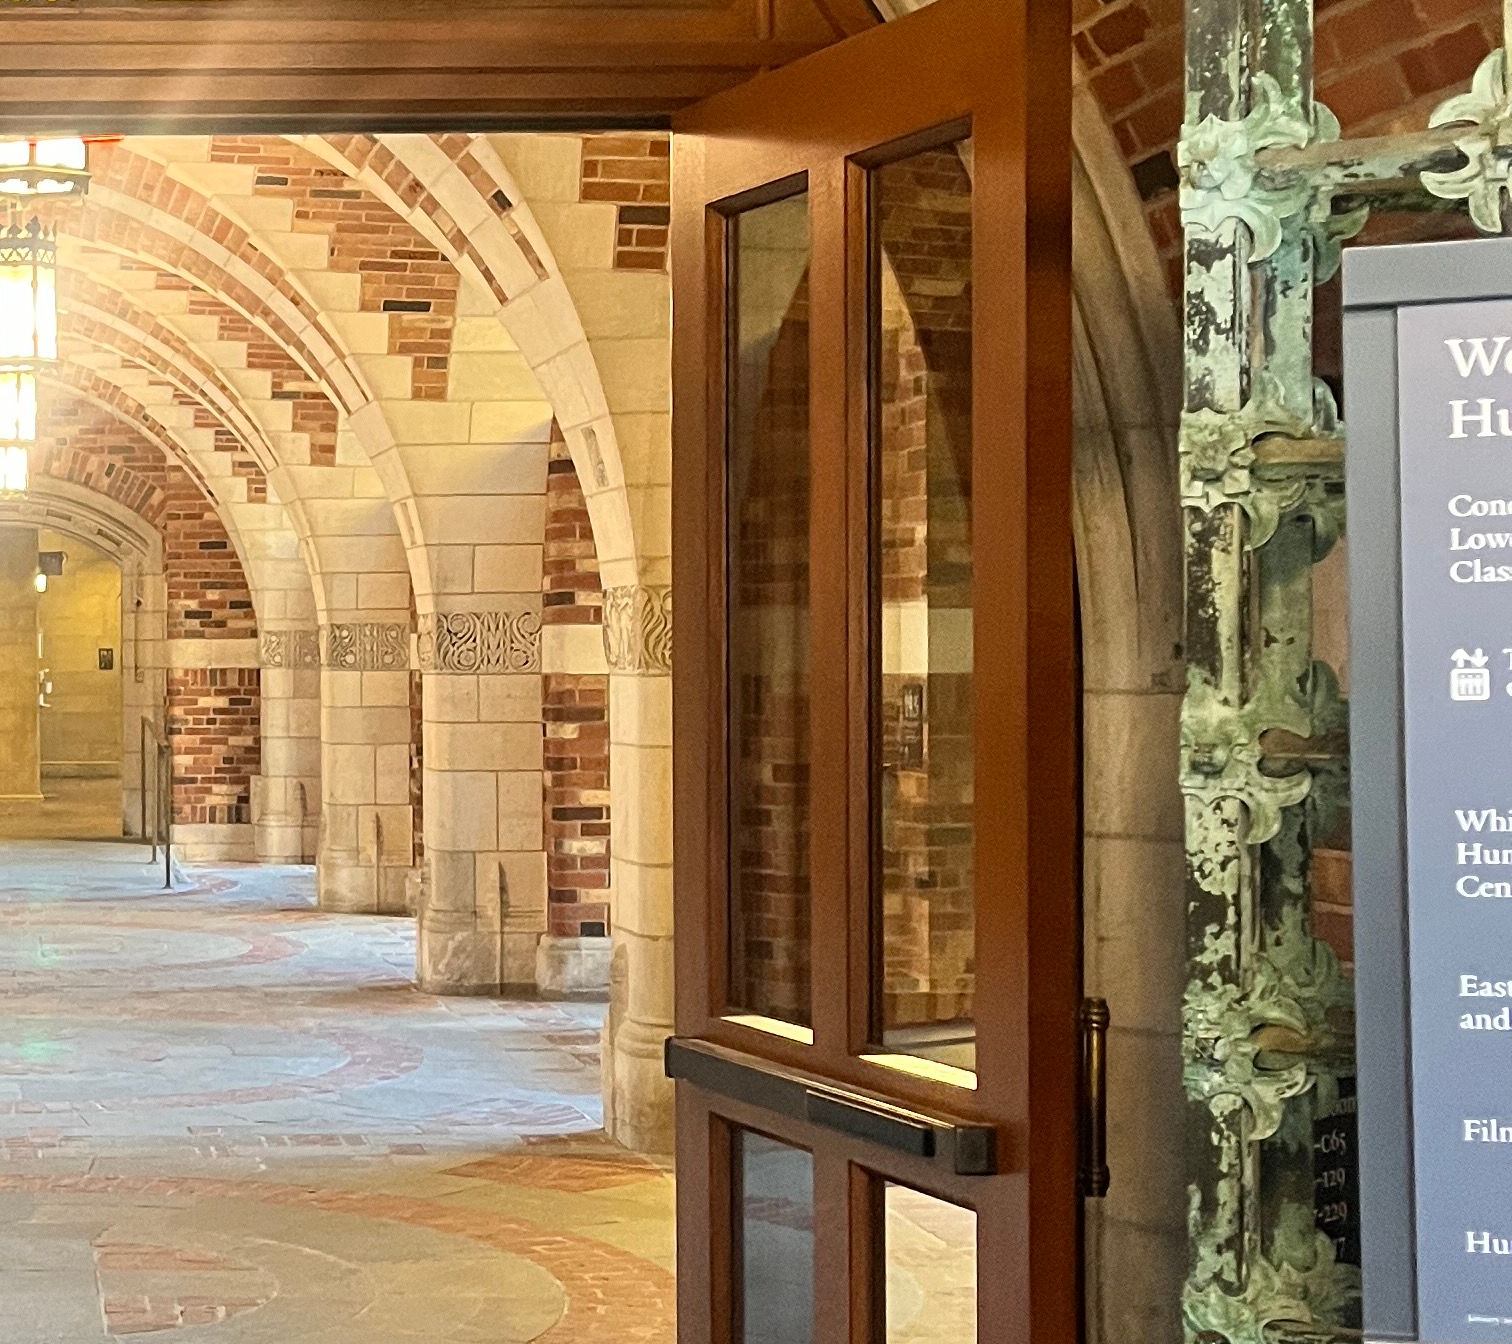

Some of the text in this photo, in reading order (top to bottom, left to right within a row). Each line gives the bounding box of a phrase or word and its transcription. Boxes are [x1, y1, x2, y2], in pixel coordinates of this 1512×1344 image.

[1448, 495, 1512, 518] Con
[1449, 528, 1512, 551] Low
[1459, 1007, 1510, 1031] and
